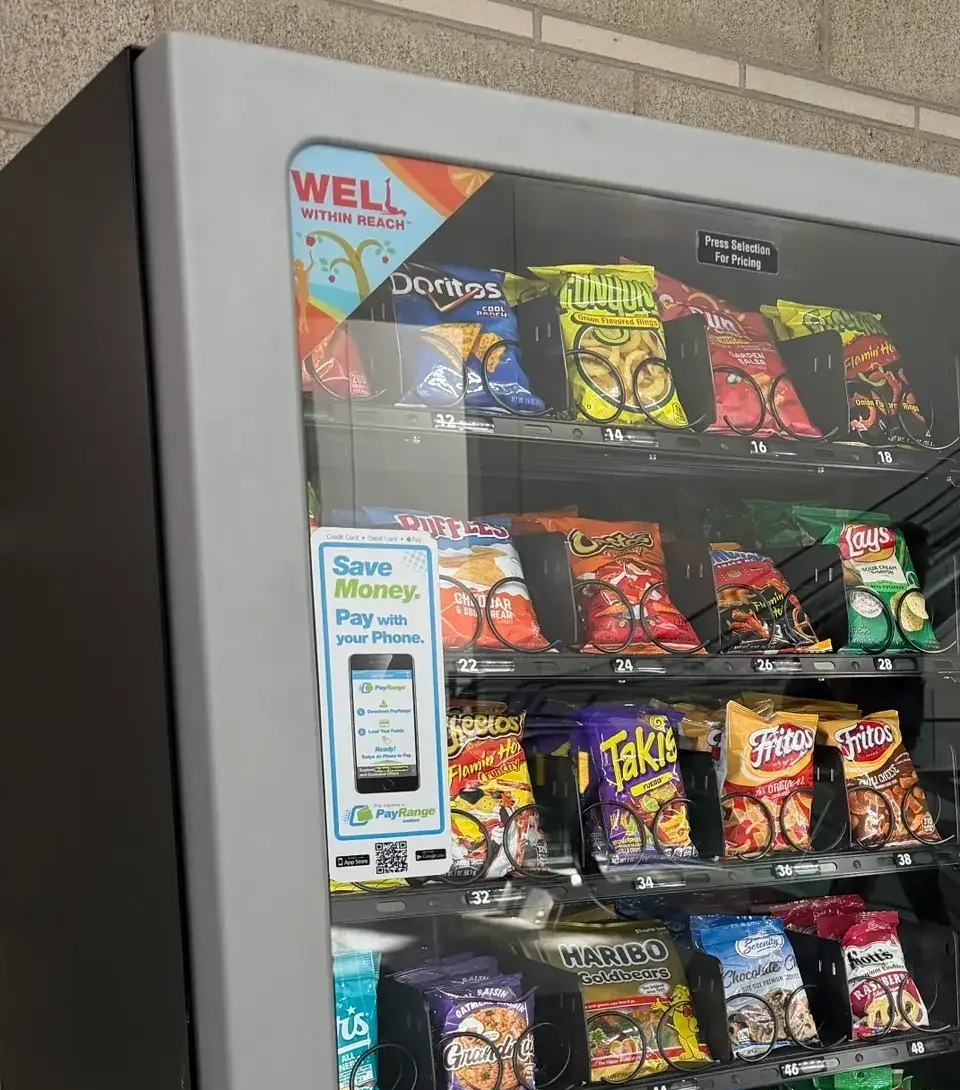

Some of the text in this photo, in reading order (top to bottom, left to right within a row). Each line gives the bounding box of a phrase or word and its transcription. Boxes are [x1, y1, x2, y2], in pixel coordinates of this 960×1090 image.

[291, 168, 407, 217] WELL
[301, 207, 406, 231] WITHIN REACH
[704, 235, 771, 257] Press Selection
[714, 251, 762, 271] For Pricing
[389, 272, 502, 300] Doritos
[577, 314, 600, 324] Onion
[601, 316, 635, 326] Flavored
[604, 428, 624, 441] 14
[749, 440, 768, 455] 16
[877, 451, 894, 465] 18
[332, 555, 393, 577] Save
[334, 578, 421, 604] Money.
[335, 608, 408, 629] Pay with
[336, 631, 425, 647] your Phone.
[458, 659, 479, 673] 22
[615, 658, 634, 672] 24
[756, 658, 774, 672] 26
[877, 658, 893, 671] 28
[748, 723, 814, 770] Fritos
[833, 720, 894, 761] Fritos
[599, 726, 678, 792] Takis
[476, 757, 521, 785] Crunchy
[877, 766, 901, 784] CHEESE
[642, 778, 663, 791] FUEGO
[375, 807, 436, 820] PayRange
[897, 853, 913, 866] 38
[777, 864, 793, 877] 36
[636, 876, 654, 890] 34
[471, 890, 491, 904] 32
[558, 938, 669, 969] HARIBO
[742, 937, 780, 955] Serenity
[577, 967, 672, 986] Goldbears
[723, 961, 781, 989] Chocolate
[911, 1041, 925, 1054] 48
[341, 1053, 356, 1063] ALL
[783, 1063, 799, 1075] 46
